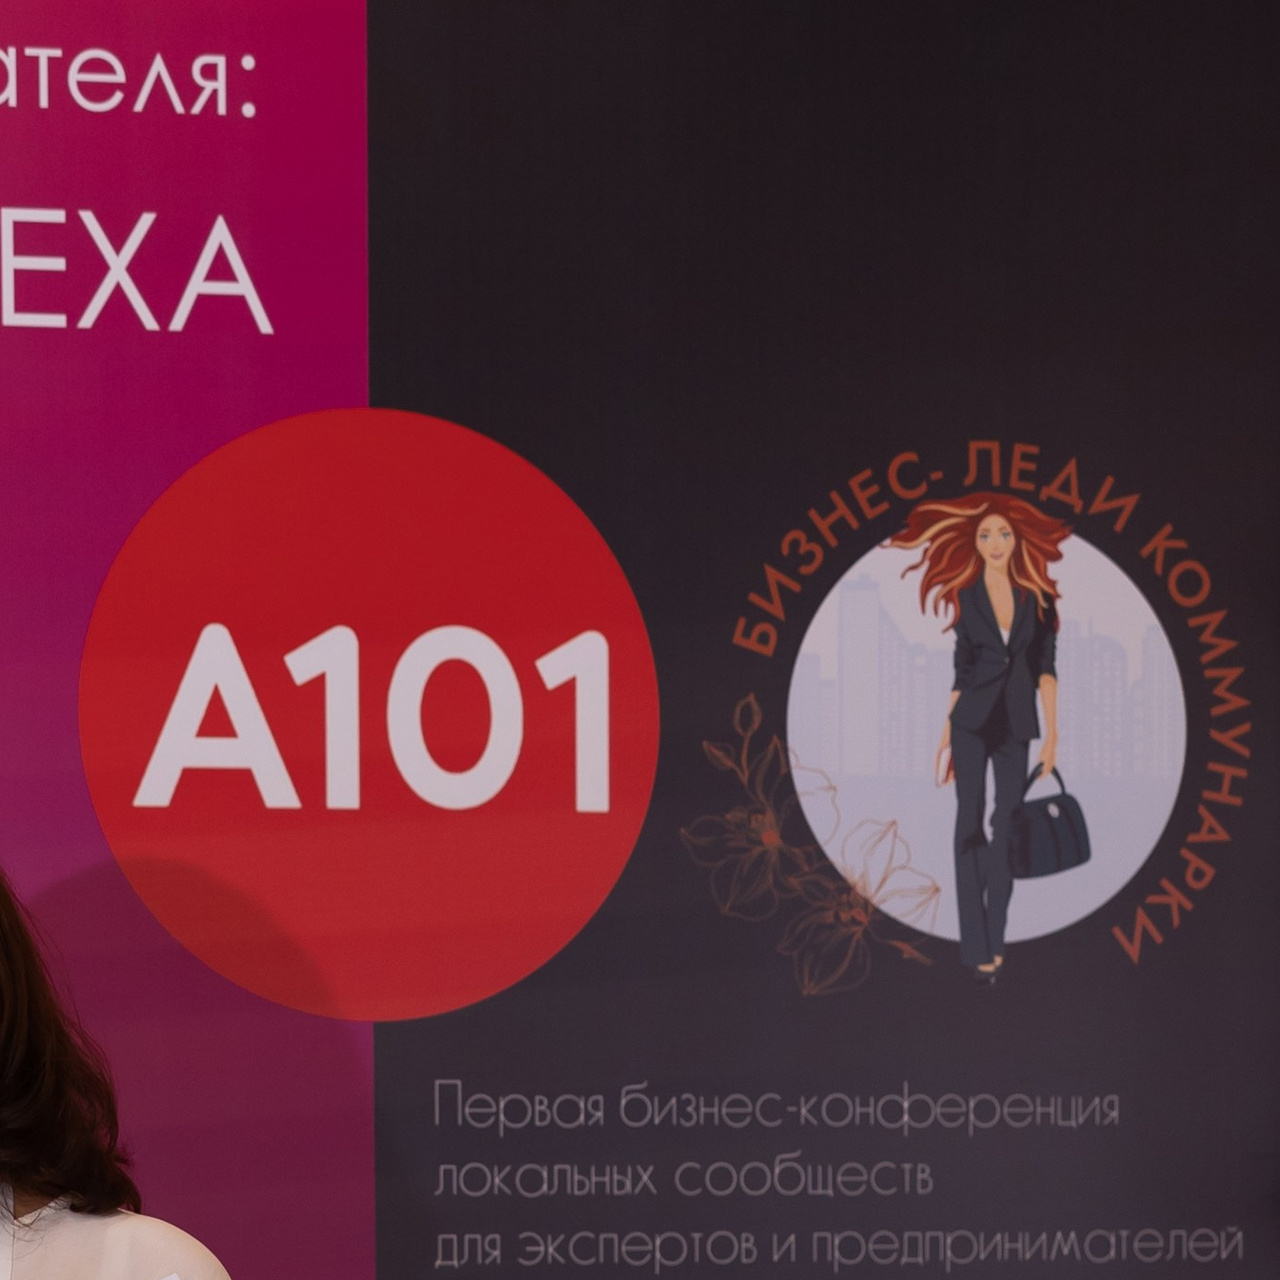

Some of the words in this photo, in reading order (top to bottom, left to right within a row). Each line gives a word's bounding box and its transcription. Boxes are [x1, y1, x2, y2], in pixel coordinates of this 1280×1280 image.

[732, 450, 944, 657] БИЗНЕС-
[963, 440, 1140, 533] ЛЕДИ
[1111, 523, 1252, 964] КОММУНАРКИ
[434, 1079, 605, 1137] Первая
[620, 1080, 1120, 1137] бизнес-конференция
[434, 1162, 657, 1198] локальных
[674, 1149, 934, 1198] сообществ
[434, 1233, 502, 1269] для
[518, 1230, 758, 1275] экспертов
[772, 1233, 797, 1263] и
[812, 1226, 1244, 1274] предпринимателей
